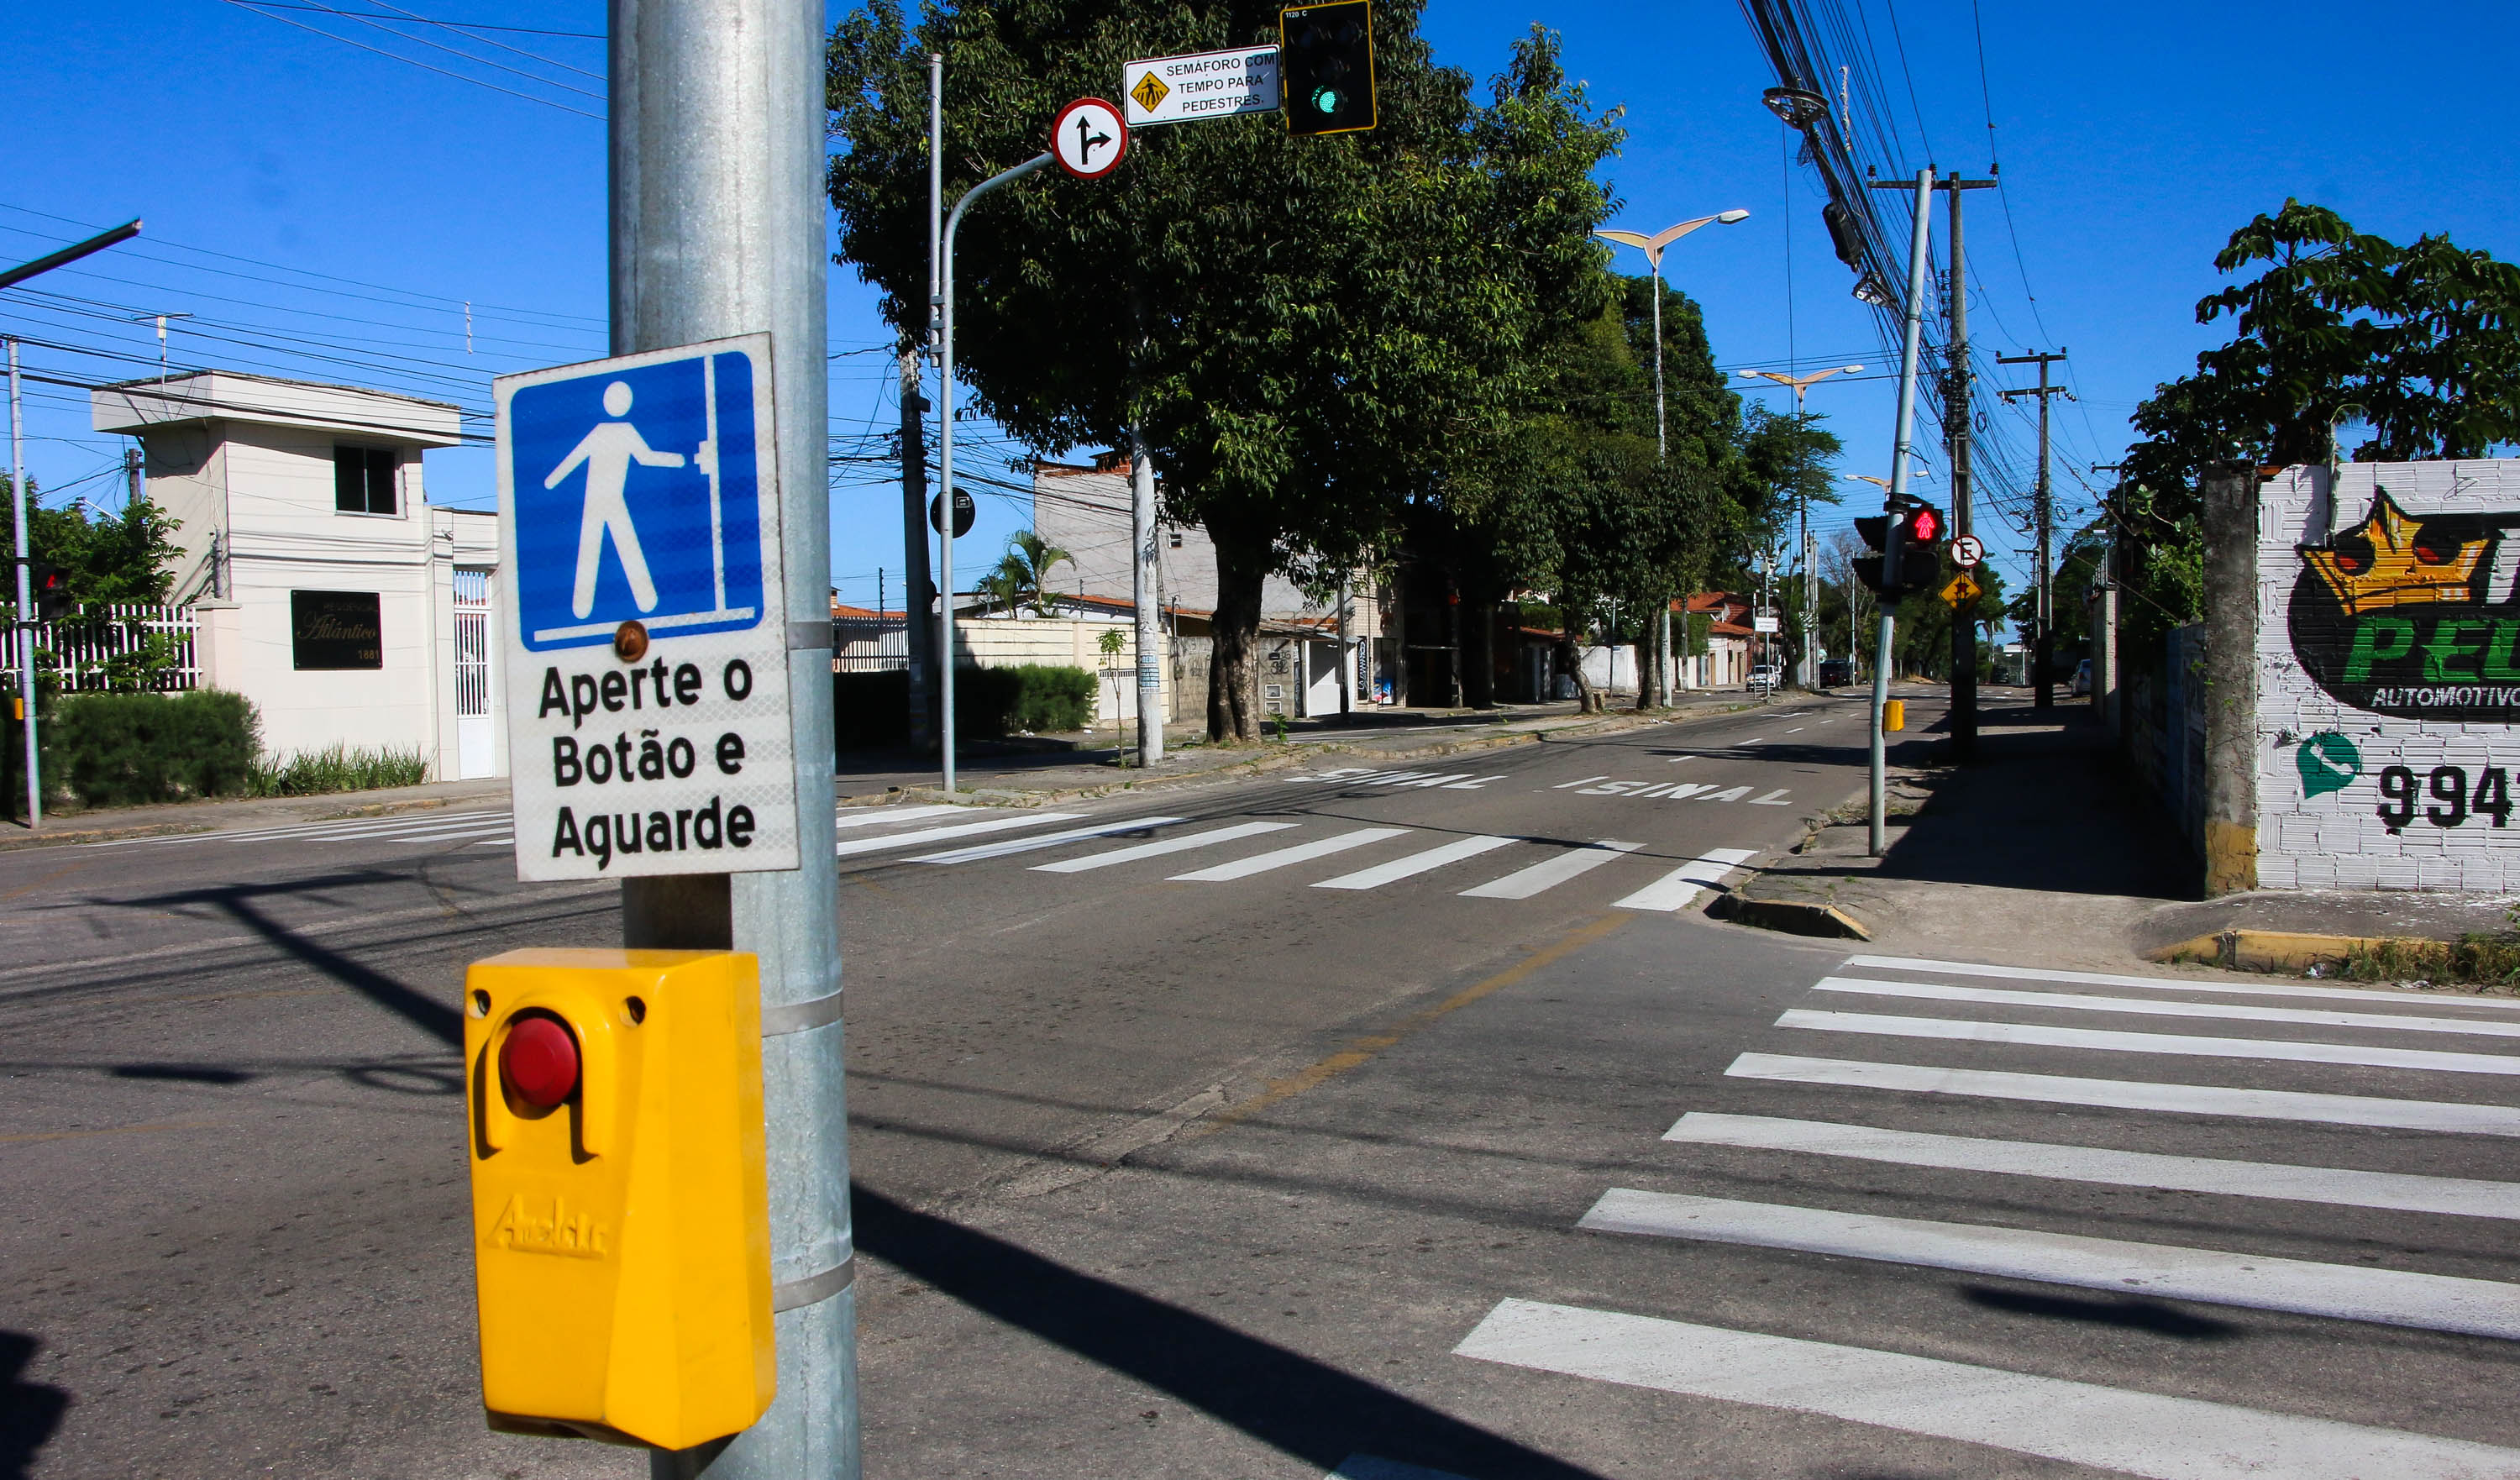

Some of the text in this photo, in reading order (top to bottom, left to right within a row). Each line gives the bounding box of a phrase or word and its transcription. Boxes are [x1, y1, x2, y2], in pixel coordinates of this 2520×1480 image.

[1167, 54, 1275, 76] SEMÁFORO COM
[1178, 74, 1264, 94] TEMPO PARA
[1182, 94, 1264, 113] PEDESTRES.
[1961, 542, 1973, 560] E
[357, 649, 380, 659] 1881
[538, 656, 753, 730] Aperte o
[553, 729, 746, 788] Botão e
[1575, 780, 1793, 806] SINAL
[2377, 765, 2520, 828] 994
[552, 795, 756, 871] Aguarde
